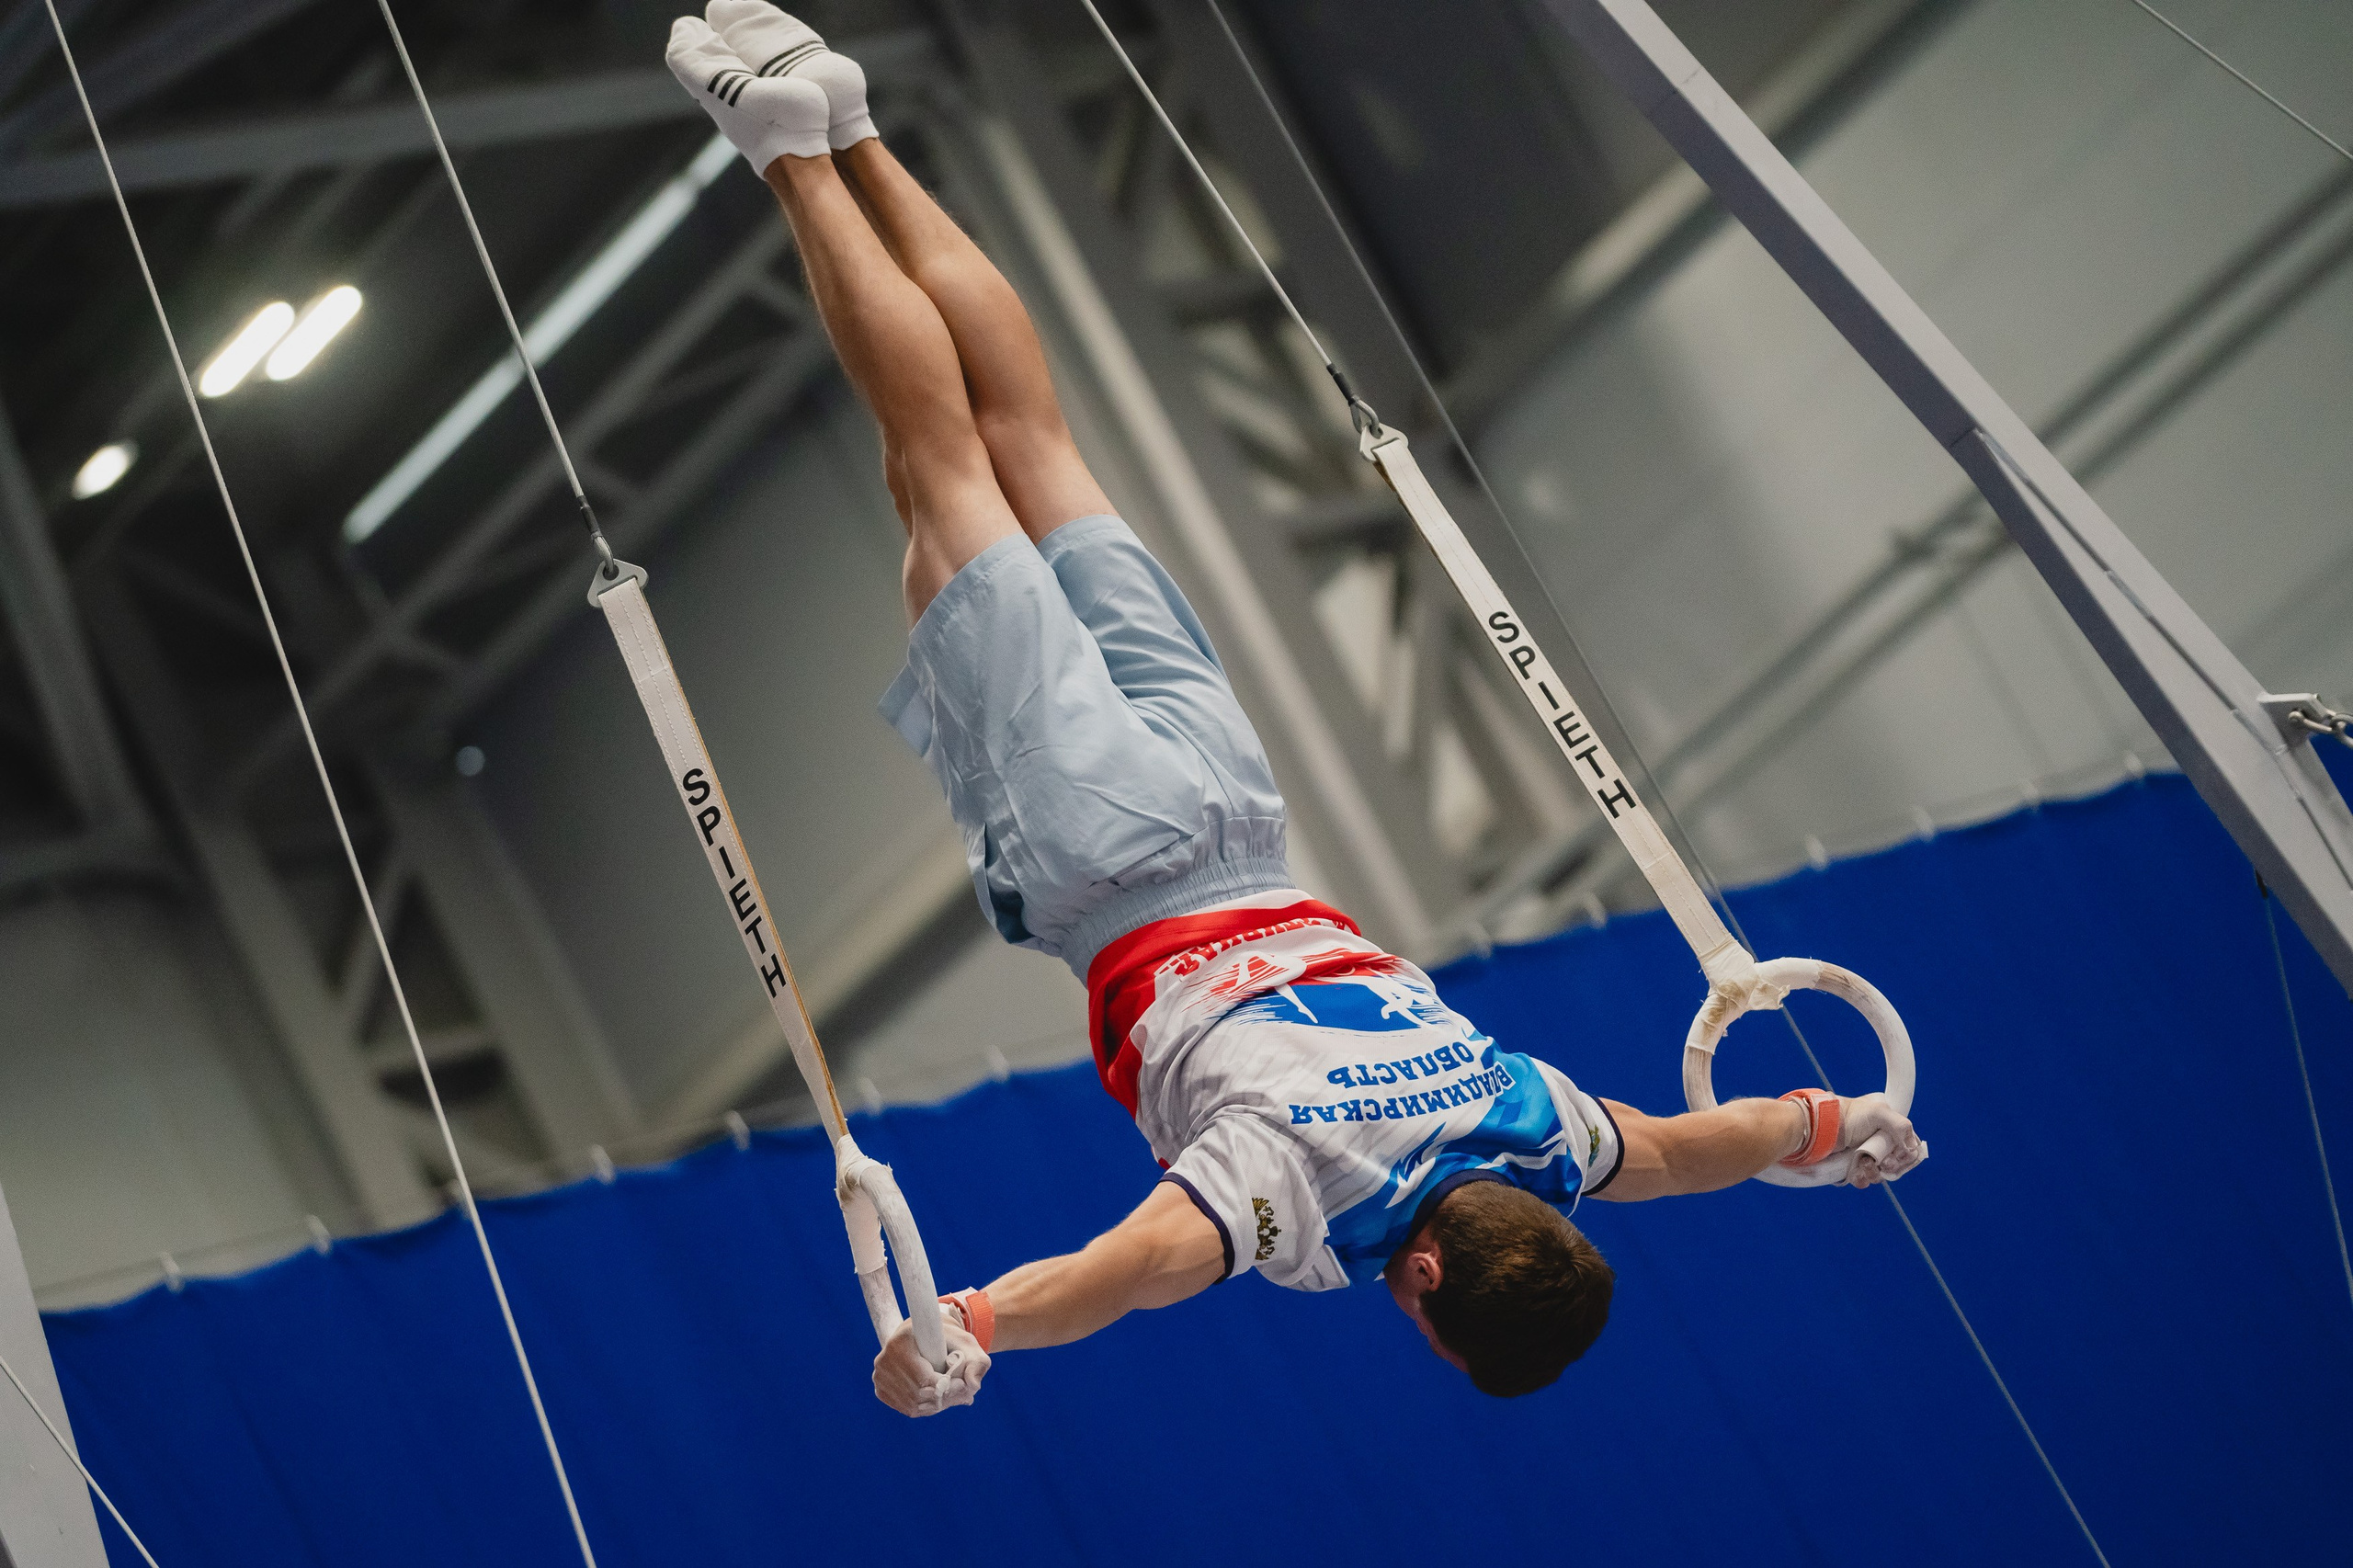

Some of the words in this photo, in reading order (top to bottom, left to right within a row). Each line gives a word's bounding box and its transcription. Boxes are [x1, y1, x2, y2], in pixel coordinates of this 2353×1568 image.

[1488, 611, 1637, 819] SPIETH
[682, 767, 787, 998] SPIETH
[1288, 1062, 1514, 1125] ВЛАДИМИРСКАЯ
[1326, 1041, 1475, 1089] ОБЛАСТЬ
